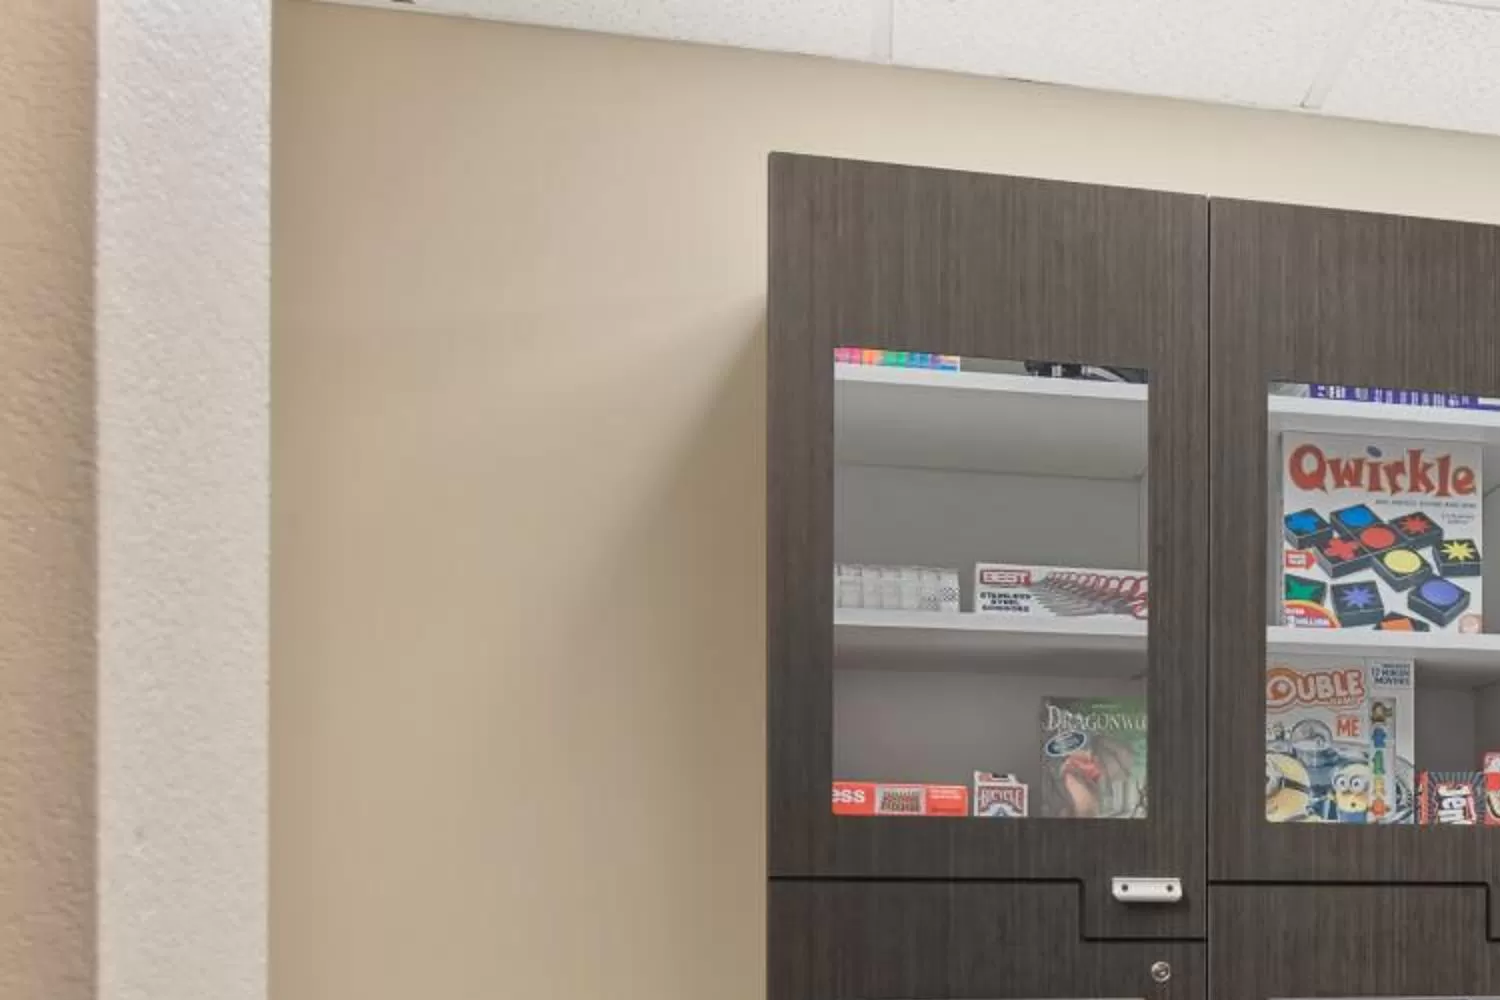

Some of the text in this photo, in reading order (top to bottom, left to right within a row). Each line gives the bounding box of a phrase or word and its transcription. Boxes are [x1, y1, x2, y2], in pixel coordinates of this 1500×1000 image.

[1289, 444, 1477, 497] Qwirkle
[982, 571, 1028, 584] BEST
[1336, 716, 1361, 737] ME
[980, 788, 1023, 810] BICYCLE
